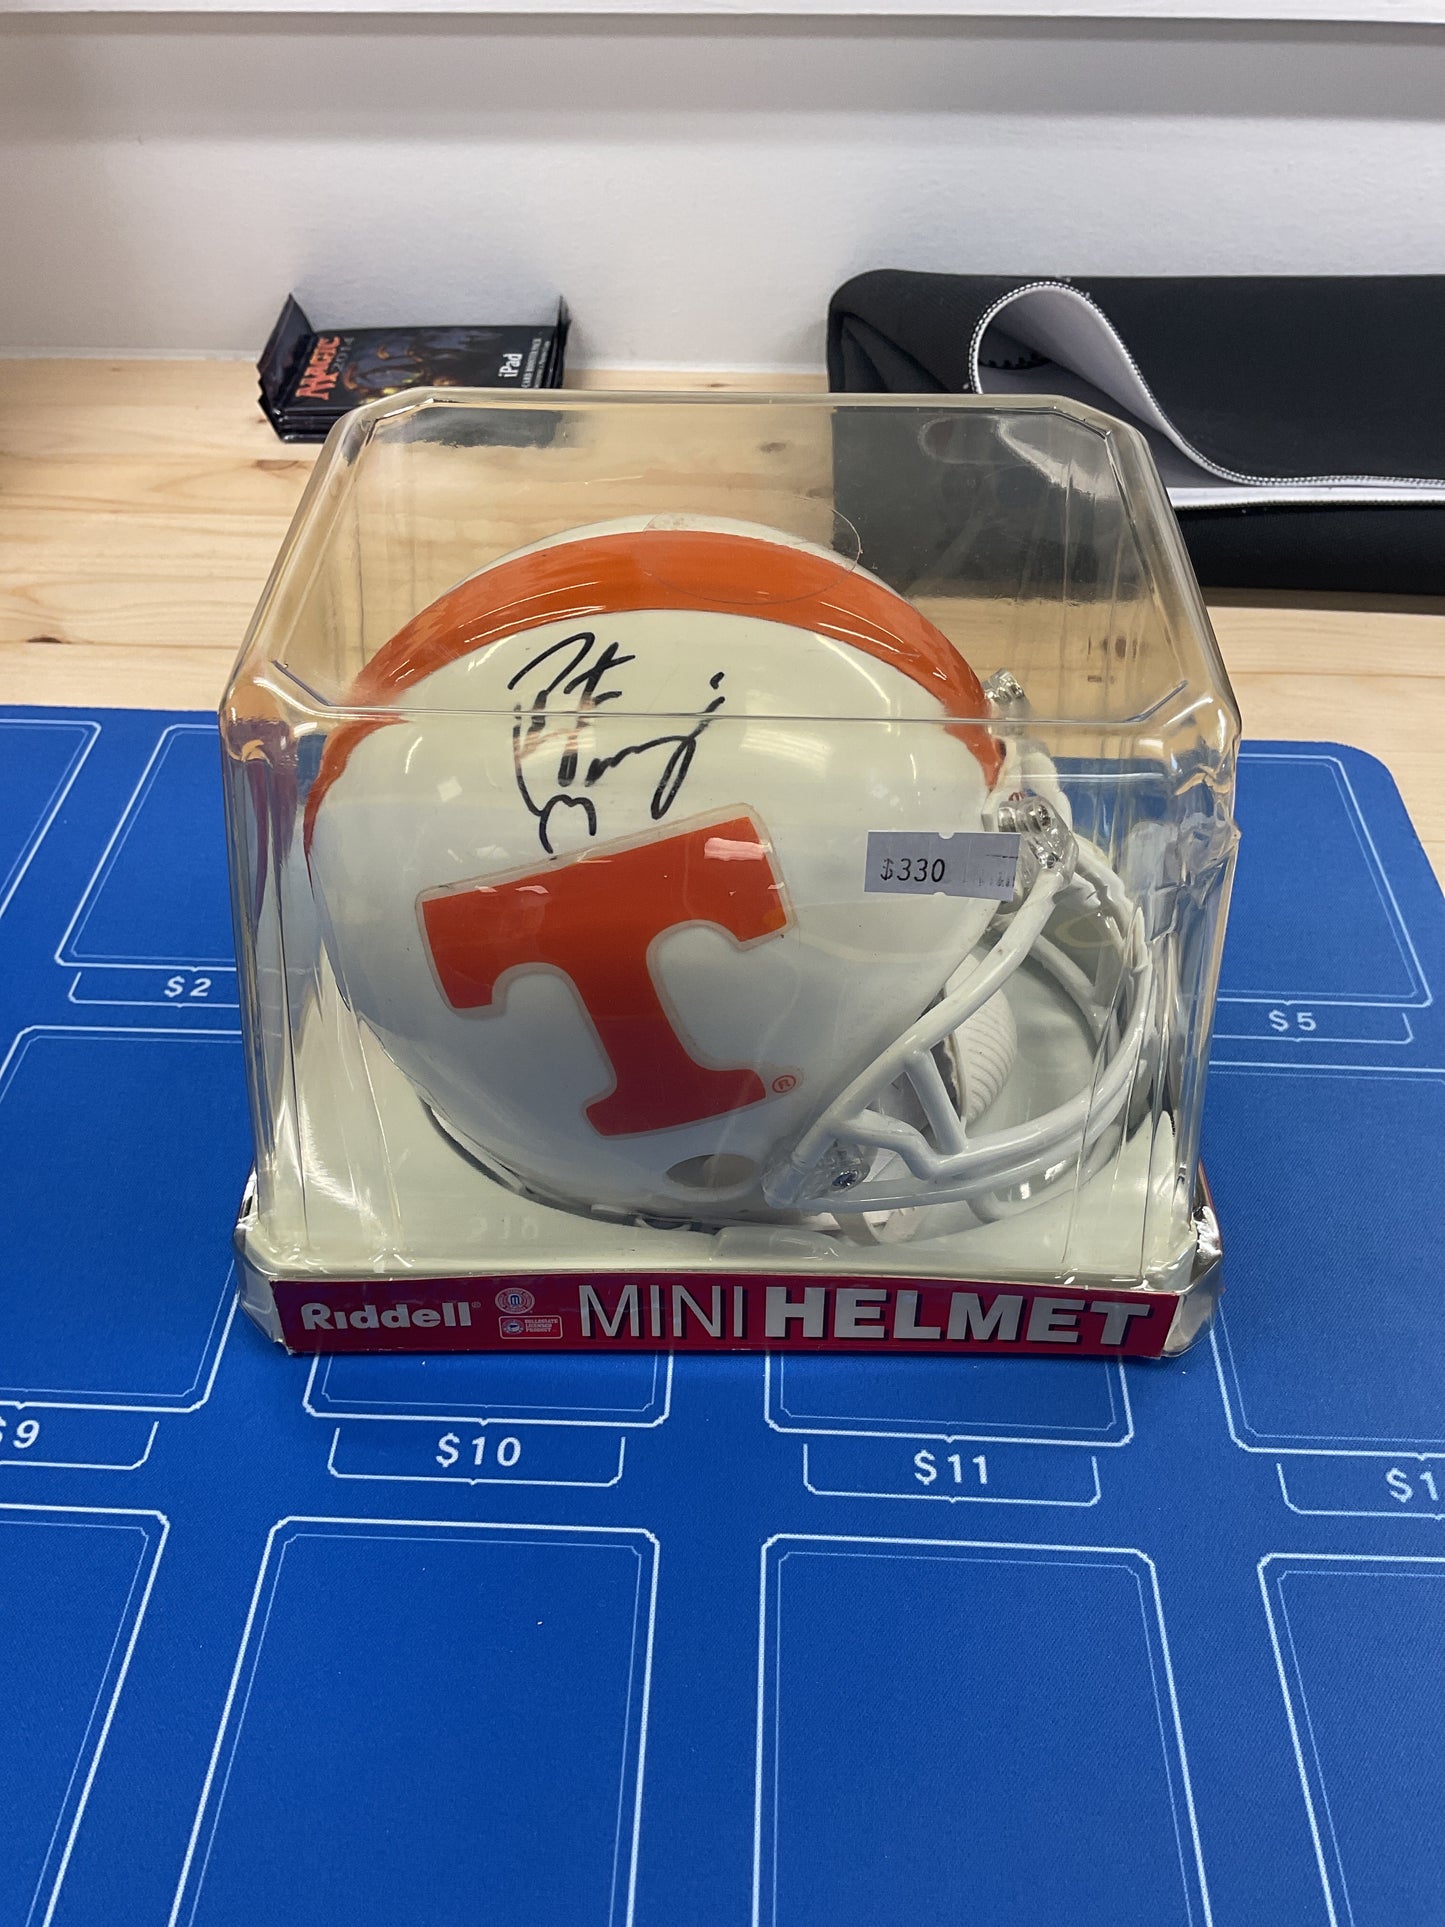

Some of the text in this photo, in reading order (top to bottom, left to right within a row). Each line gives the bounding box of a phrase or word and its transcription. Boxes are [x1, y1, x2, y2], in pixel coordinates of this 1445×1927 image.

[295, 336, 341, 400] MAGIC
[498, 353, 523, 378] iPad
[880, 858, 946, 883] $330
[163, 975, 212, 998] $2
[417, 815, 788, 1137] T
[1268, 1009, 1317, 1032] $5
[301, 1302, 472, 1330] Riddell
[578, 1284, 744, 1338] MINI
[764, 1286, 1150, 1345] HELMET
[0, 1416, 40, 1449] 9
[435, 1432, 522, 1468] $10
[913, 1449, 988, 1486] $11
